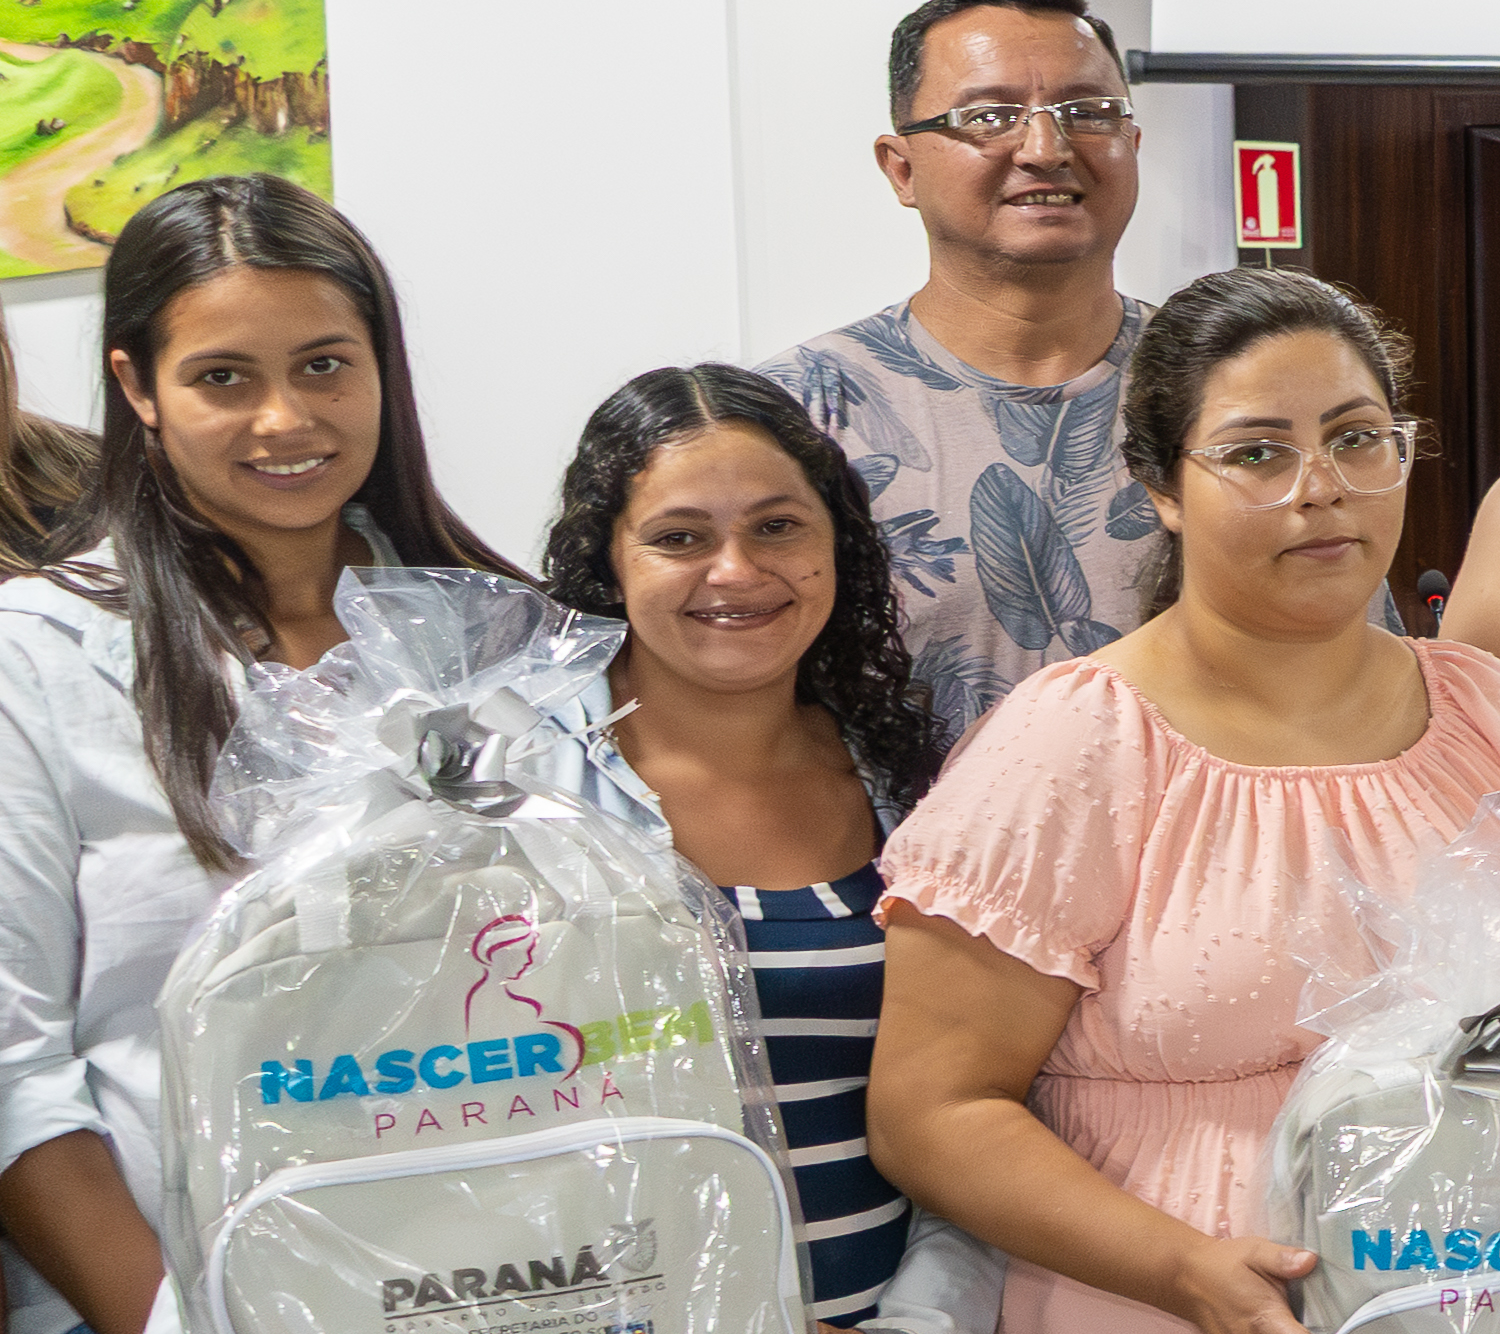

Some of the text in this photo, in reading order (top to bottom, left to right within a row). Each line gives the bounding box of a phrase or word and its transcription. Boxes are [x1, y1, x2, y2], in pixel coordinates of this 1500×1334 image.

[260, 1000, 716, 1105] NASCER BEM
[374, 1071, 626, 1139] PARANÁ
[382, 1244, 611, 1312] PARANÁ
[574, 1311, 599, 1324] DO
